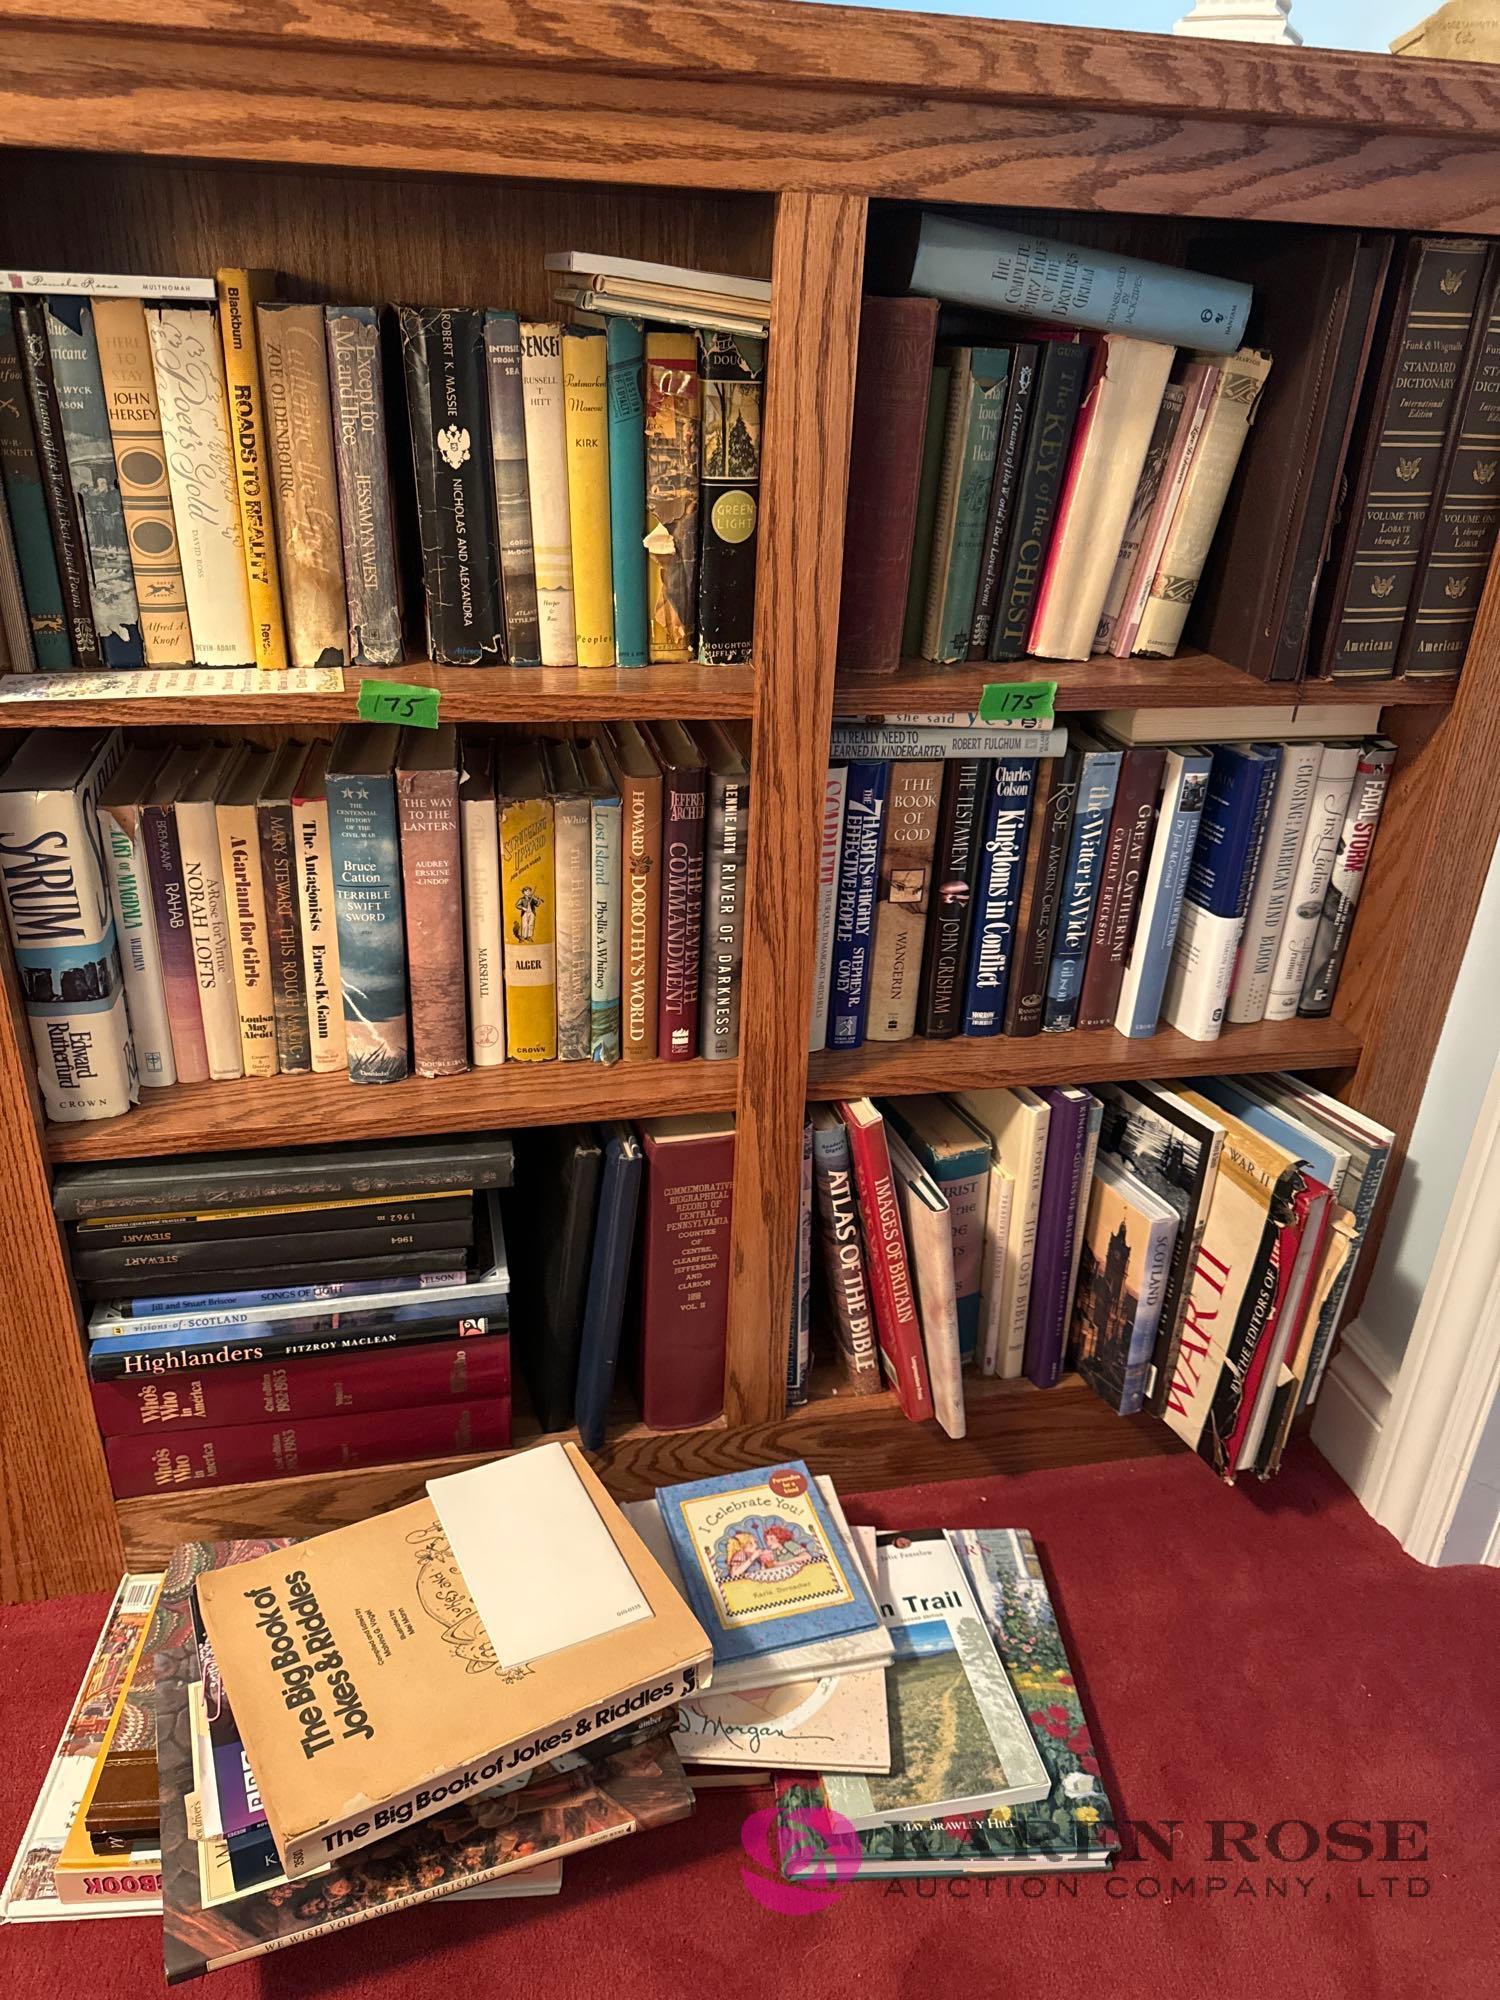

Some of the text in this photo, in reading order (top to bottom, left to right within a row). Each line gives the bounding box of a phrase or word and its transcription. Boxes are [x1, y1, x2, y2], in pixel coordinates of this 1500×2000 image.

[227, 287, 243, 350] Blackburn
[334, 330, 357, 446] Me and Thee
[441, 313, 458, 417] ROBERT MASSIE
[1396, 377, 1456, 389] DICTIONARY
[1402, 362, 1456, 373] STANDARD
[109, 407, 158, 421] HERSEY
[112, 391, 150, 405] JOHN
[158, 348, 219, 526] Poet's Gold
[233, 384, 259, 497] ROADS TO
[576, 438, 598, 447] KIRK
[355, 471, 378, 589] JESSAMYN WEST
[717, 504, 754, 516] GREEN
[717, 519, 752, 530] LIGHT
[1006, 411, 1069, 639] KEY CHEST
[453, 478, 473, 627] NICHOLAS AND ALEXANDRA
[373, 693, 428, 718] 175
[1000, 692, 1041, 712] 175
[879, 745, 945, 756] KINDERGARTEN
[952, 739, 1021, 749] ROBERT FULGHUM
[902, 778, 934, 790] THE
[996, 767, 1031, 782] Charles
[997, 782, 1027, 796] Colson
[403, 798, 453, 808] THE WAY
[409, 811, 450, 820] TO THE
[632, 791, 644, 857] HOWARD
[723, 784, 738, 854] RENNIE AIRTH
[895, 795, 936, 807] BOOK
[904, 813, 924, 824] OF
[951, 766, 977, 873] THE TESTAMENT
[1088, 785, 1111, 819] the
[403, 821, 456, 831] LANTERN
[895, 828, 930, 841] GOD
[1076, 818, 1104, 879] Water
[1344, 780, 1385, 871] FATAL STORM
[2, 830, 85, 943] SARUM
[342, 871, 380, 883] Catton
[344, 861, 376, 872] Bruce
[416, 860, 449, 868] AUDREY
[838, 816, 862, 941] EFFECTIVE PEOPLE
[849, 799, 882, 936] 7 HABITS HIGHLY
[1111, 804, 1151, 962] GREAT CATHERINE
[1310, 837, 1337, 894] Ladies
[165, 882, 184, 929] RAHAB
[230, 836, 261, 986] A Garland for Girls
[338, 891, 390, 899] TERRIBLE
[346, 912, 385, 921] SWORD
[348, 902, 381, 911] SWIFT
[977, 809, 1025, 988] Kingdoms in Conflict
[1095, 886, 1113, 946] ERICKSON
[1254, 828, 1301, 975] AMERICAN MIND BLOOM
[185, 862, 217, 989] NORAH LOFTS
[301, 820, 328, 1038] The Antagonists Ernest Gann
[665, 842, 688, 1016] COMMANDMENT
[1065, 896, 1090, 948] Wide
[516, 960, 541, 970] ALGER
[630, 874, 647, 1041] DOROTHY'S WORLD
[715, 865, 736, 1034] RIVER OF DARKNESS
[849, 947, 864, 992] STEPHEN
[895, 932, 908, 1001] WANGERIN
[934, 917, 960, 1014] JOHN GRISHAM
[479, 948, 489, 998] MARSHALL
[836, 959, 852, 992] COVEY
[241, 1015, 273, 1024] Louisa
[243, 1030, 273, 1038] Alcott
[47, 1023, 80, 1088] Rutherfurd
[69, 1031, 98, 1078] Edward
[60, 1099, 107, 1109] CROWN
[1230, 1147, 1271, 1187] WAR II
[666, 1218, 729, 1231] PENNSYLVANIA
[828, 1171, 857, 1242] ATLAS
[839, 1245, 859, 1272] OF
[874, 1177, 913, 1324] IMAGES OF BRITAIN
[1147, 1235, 1169, 1306] SCOTLAND
[842, 1274, 867, 1316] THE
[188, 1313, 248, 1326] SCOTLAND
[1166, 1247, 1231, 1418] WAR II
[1247, 1292, 1269, 1346] EDITORS
[124, 1334, 397, 1374] Highlanders FITZROY MACLEAN
[851, 1317, 875, 1373] BIBLE
[138, 1384, 159, 1425] Who's
[162, 1390, 179, 1422] Who
[190, 1380, 207, 1419] America
[706, 1495, 805, 1526] Celebrate You!
[903, 1591, 963, 1614] Trail
[243, 1586, 334, 1759] The Big Book of
[285, 1570, 374, 1740] Jokes & Riddles
[321, 1682, 674, 1853] The Big Book of Jokes & Riddles
[374, 1870, 497, 1917] MERRY CHRISTMAS
